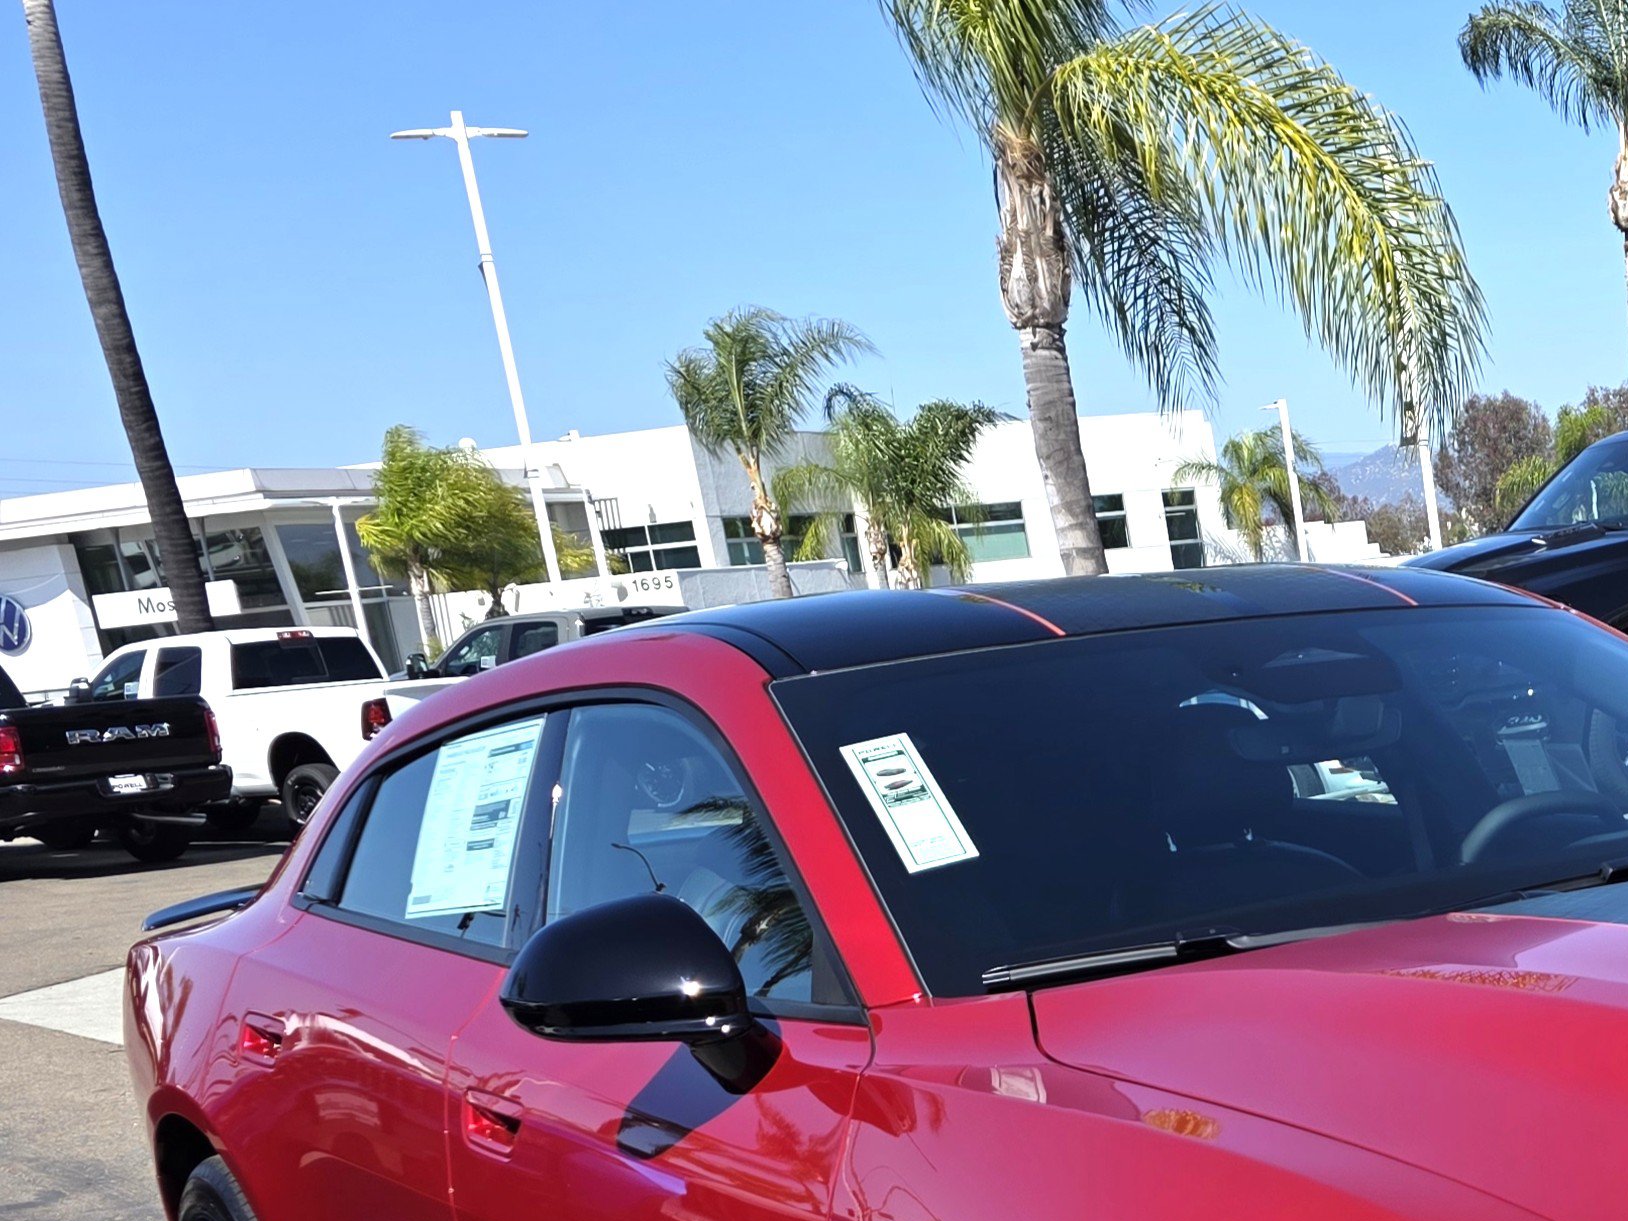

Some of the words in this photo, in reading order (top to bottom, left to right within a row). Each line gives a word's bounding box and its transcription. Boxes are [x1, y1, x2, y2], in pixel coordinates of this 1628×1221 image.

[632, 576, 674, 592] 1695
[137, 597, 176, 614] Mos
[65, 722, 171, 745] RAM
